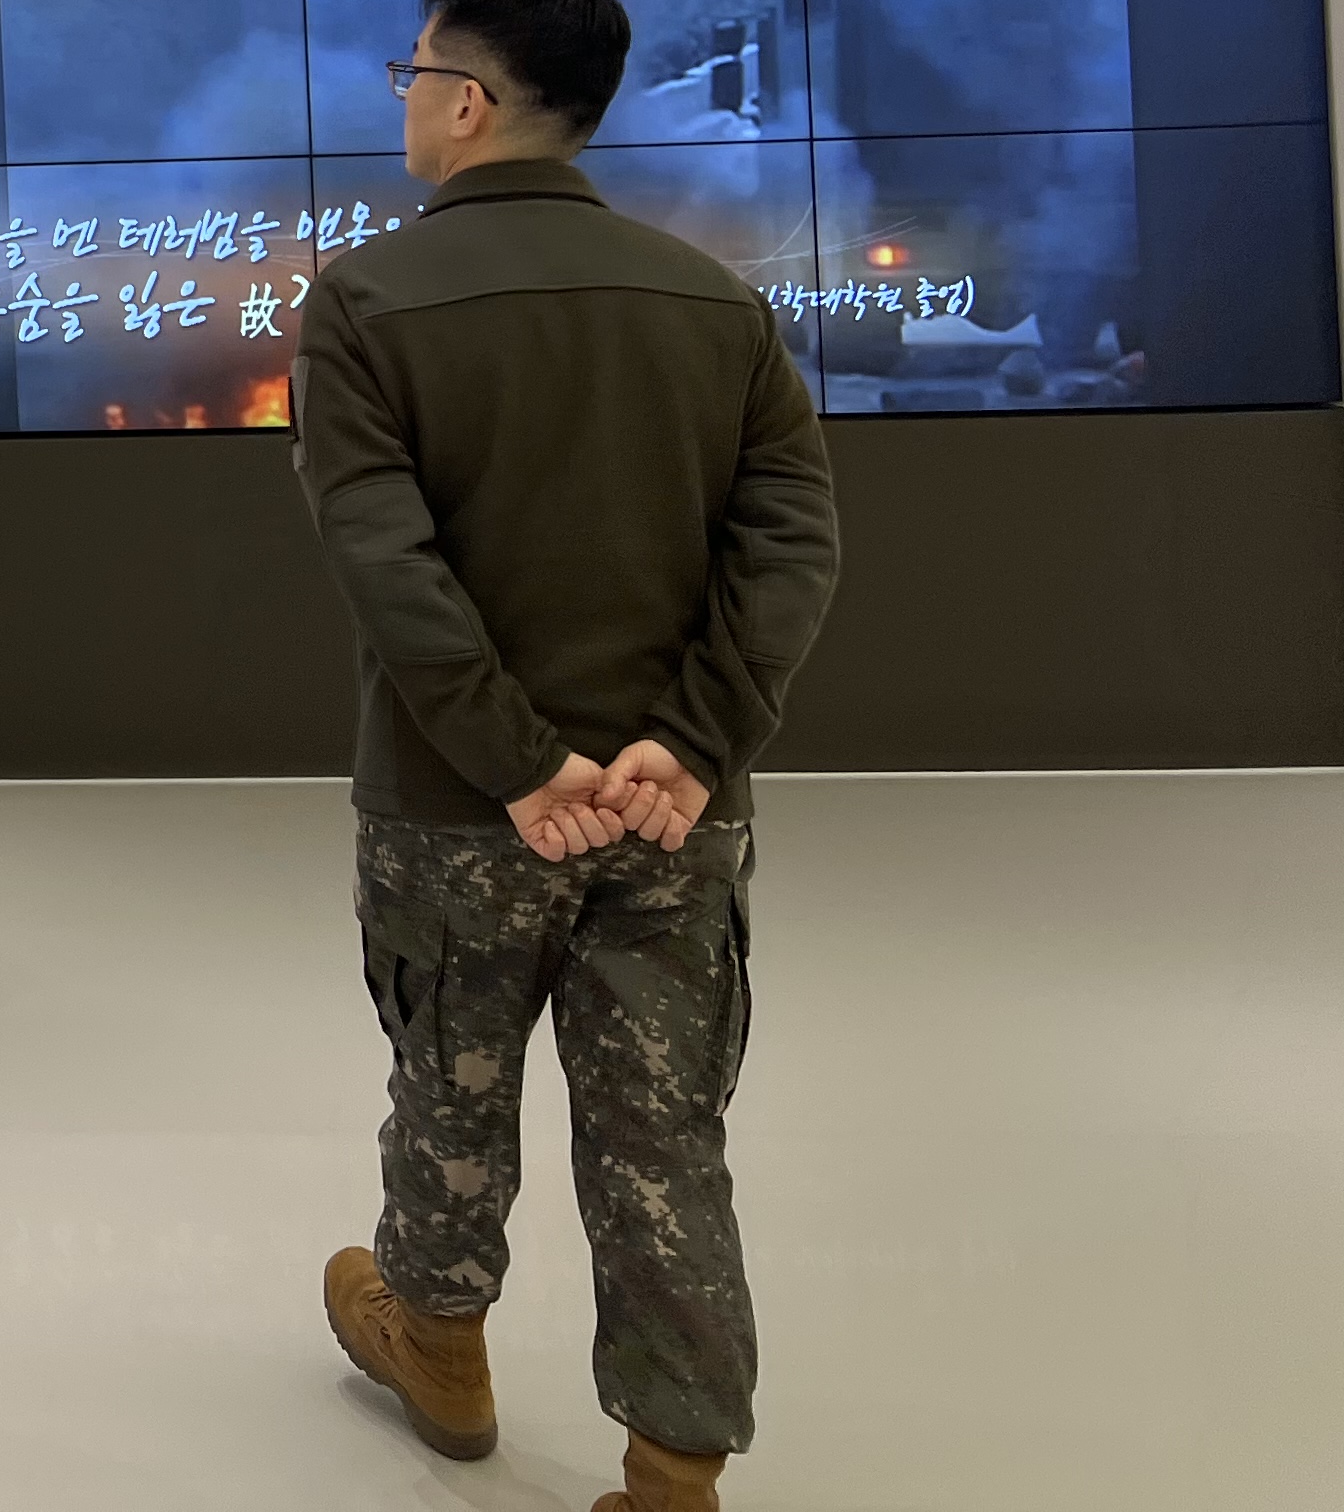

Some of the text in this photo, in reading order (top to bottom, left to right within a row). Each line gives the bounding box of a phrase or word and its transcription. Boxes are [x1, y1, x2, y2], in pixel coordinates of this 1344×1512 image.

[118, 208, 281, 263] 테러범을
[118, 270, 216, 339] 잃은
[915, 275, 974, 318] 졸업)
